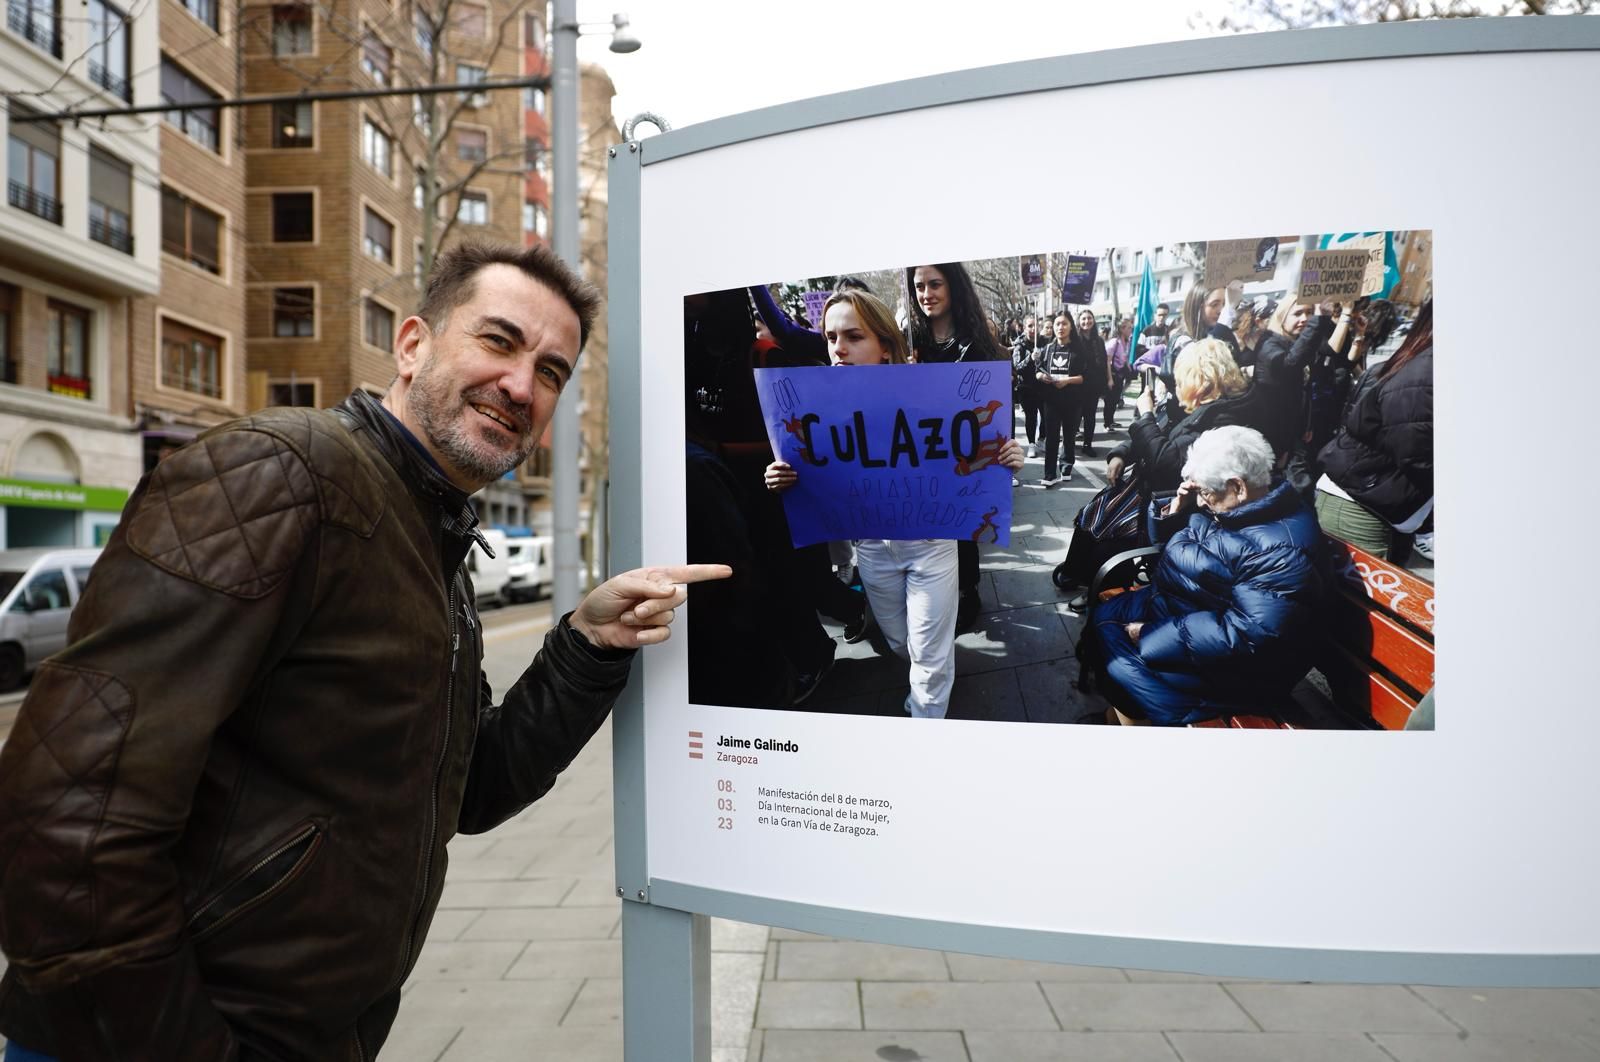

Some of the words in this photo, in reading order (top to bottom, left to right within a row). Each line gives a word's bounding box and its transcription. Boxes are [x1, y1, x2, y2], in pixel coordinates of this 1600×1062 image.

[1030, 264, 1040, 273] 8M
[958, 368, 991, 403] este
[717, 736, 751, 749] Jaime
[754, 737, 799, 752] Galindo
[717, 752, 758, 765] Zaragoza
[718, 779, 736, 792] 08.
[758, 786, 819, 801] Manifestación
[821, 793, 836, 804] del
[837, 794, 843, 804] 8
[845, 795, 857, 805] de
[859, 798, 893, 810] marzo,
[718, 799, 736, 812] 03.
[758, 801, 772, 811] Día
[774, 803, 834, 818] Internacional
[836, 808, 848, 819] de
[849, 809, 858, 820] la
[861, 811, 890, 824] Mujer,
[718, 817, 733, 830] 23
[758, 816, 769, 824] en
[771, 816, 779, 826] la
[781, 818, 802, 829] Gran
[803, 820, 818, 830] Vía
[820, 821, 831, 831] de
[833, 824, 879, 837] Zaragoza.
